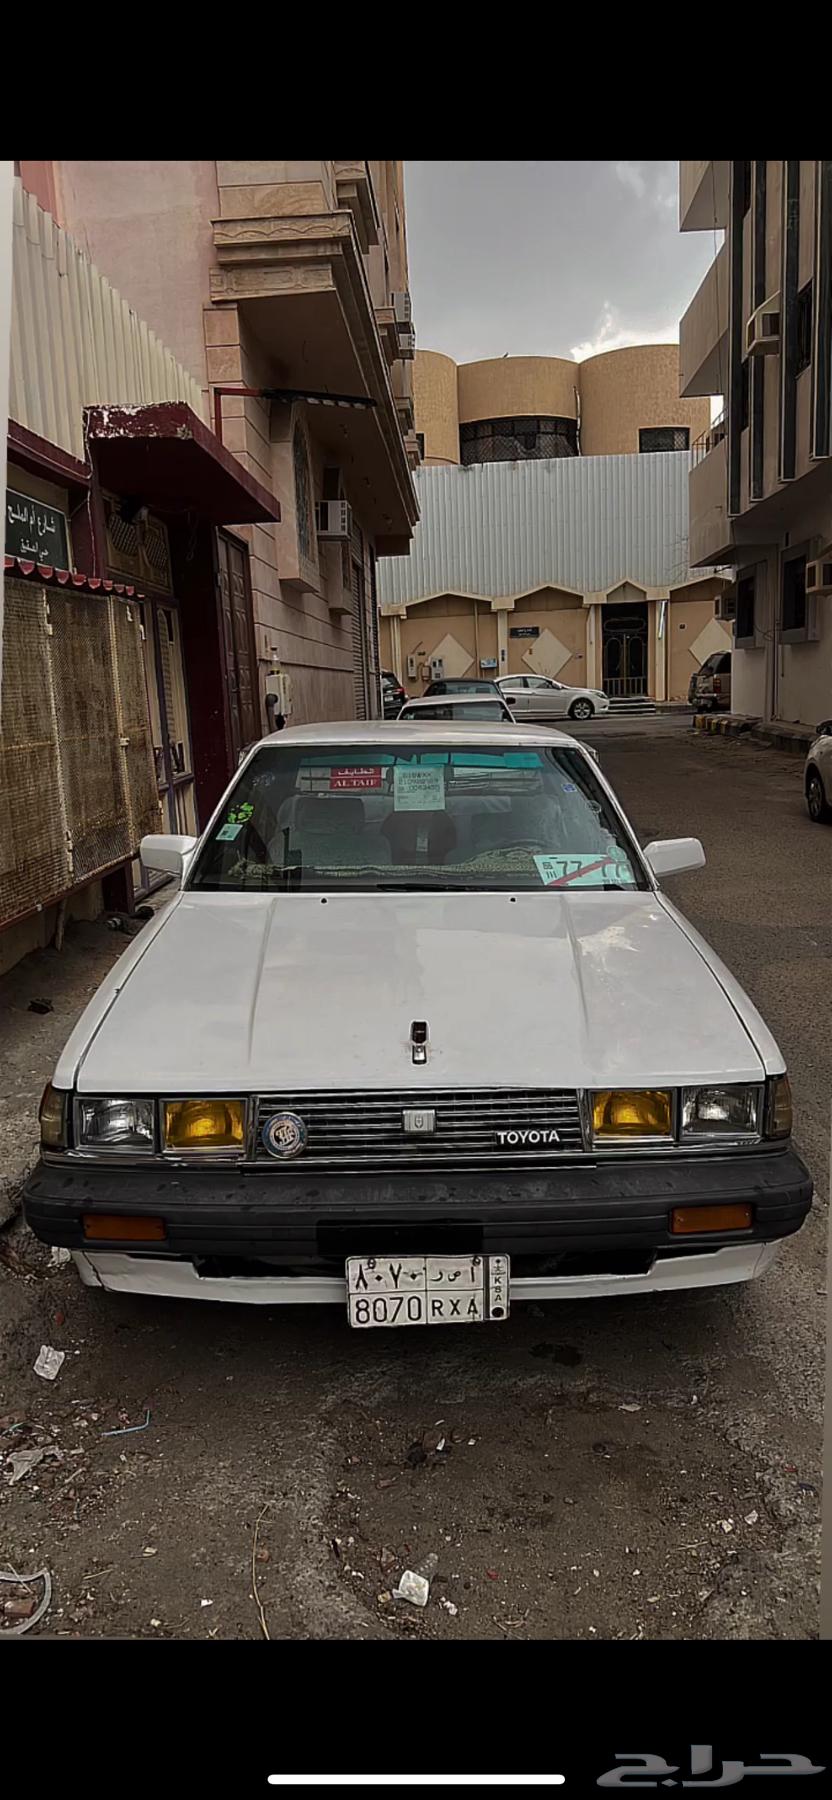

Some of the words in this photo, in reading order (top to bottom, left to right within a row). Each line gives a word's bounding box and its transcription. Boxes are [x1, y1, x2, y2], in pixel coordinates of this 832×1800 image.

[38, 514, 56, 536] شارع
[497, 1130, 560, 1144] TOYOTA
[494, 1277, 502, 1301] KSA
[355, 1296, 421, 1324] 8070
[431, 1298, 479, 1316] RXA
